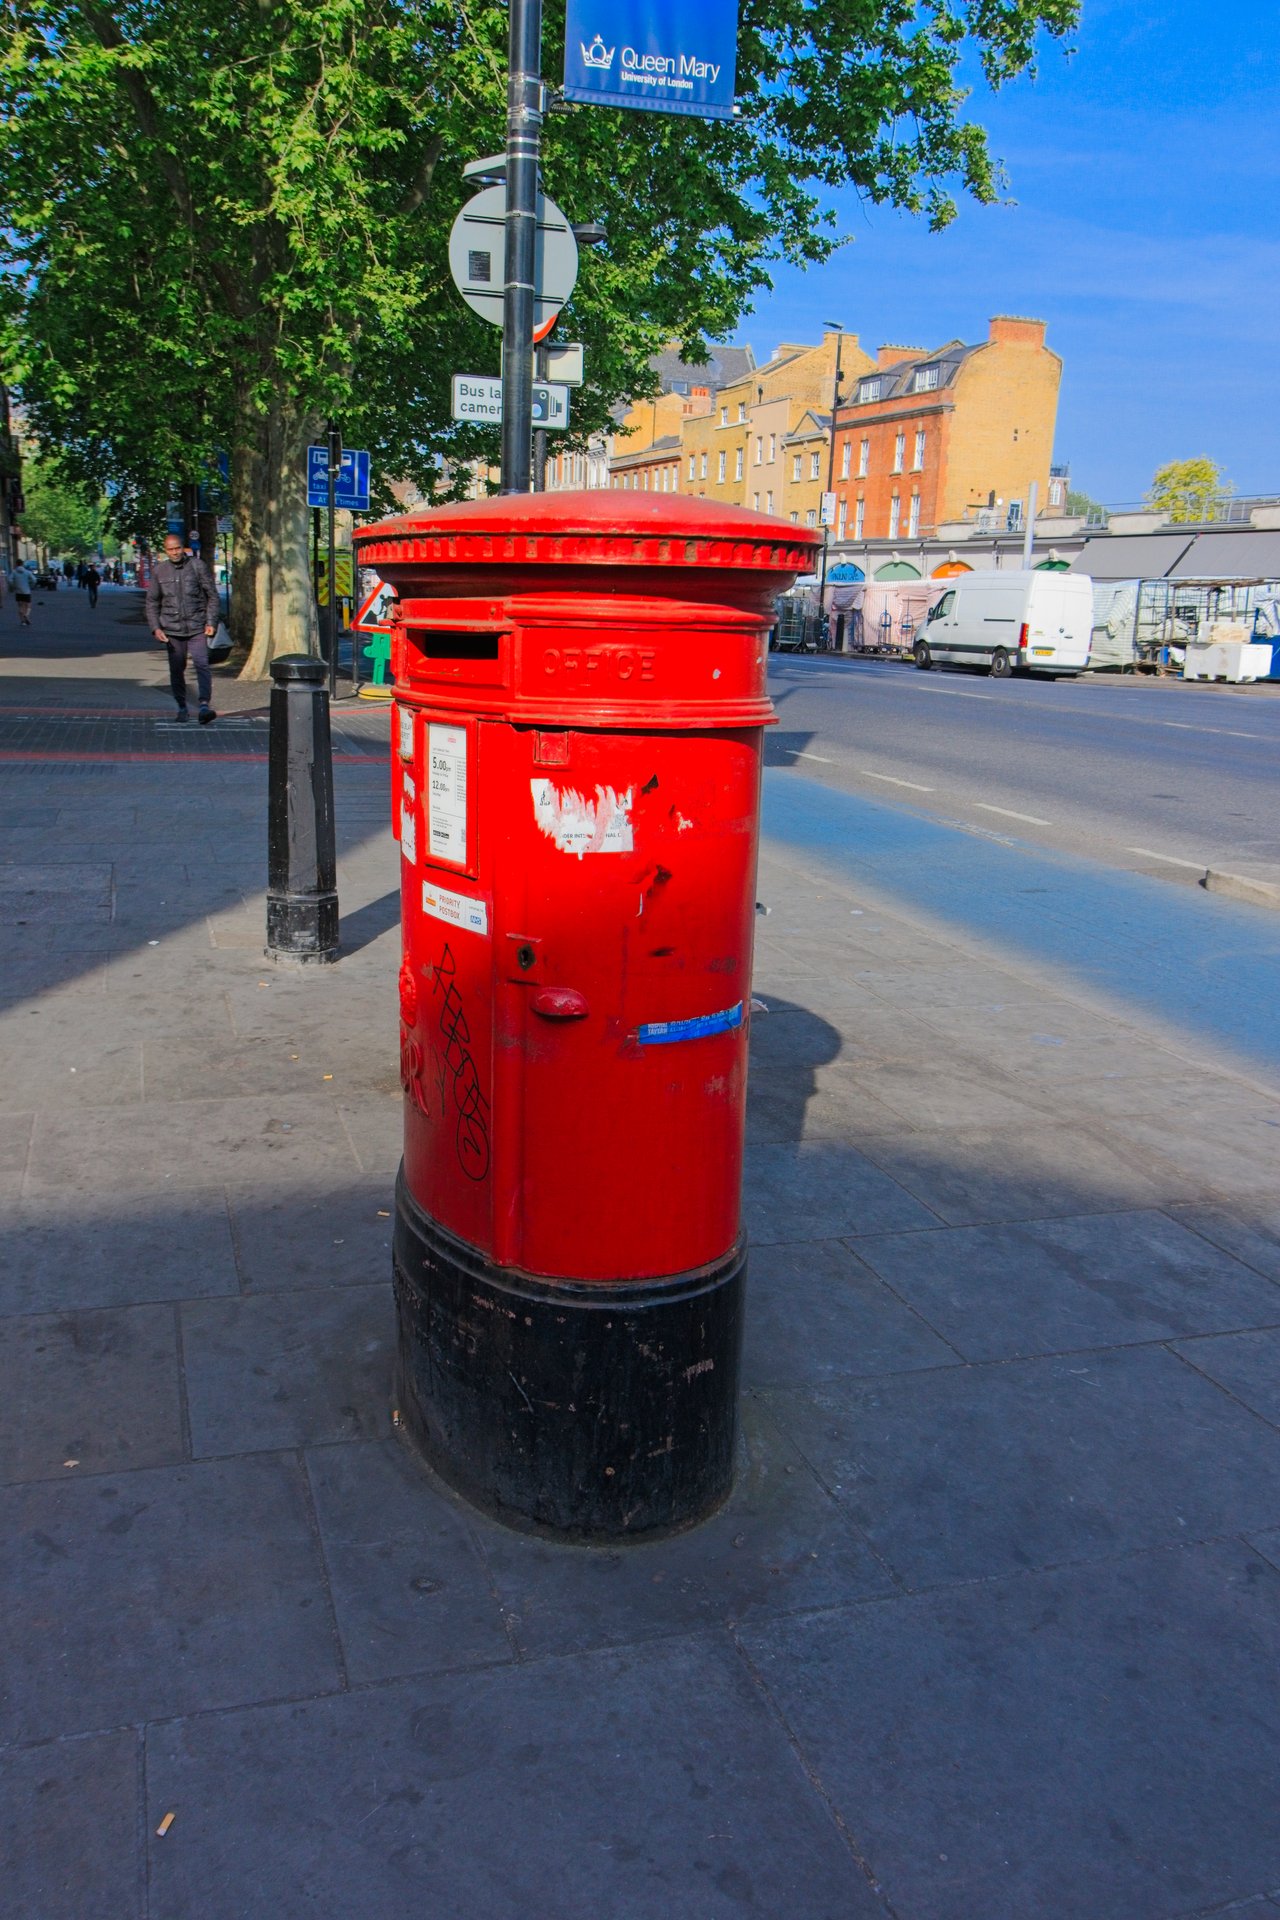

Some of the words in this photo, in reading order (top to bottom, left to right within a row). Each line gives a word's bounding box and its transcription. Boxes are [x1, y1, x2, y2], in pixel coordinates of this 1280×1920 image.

[621, 47, 675, 74] Queen
[679, 54, 721, 84] Mary
[621, 71, 657, 86] University
[658, 76, 667, 86] of
[667, 77, 694, 89] London
[460, 383, 485, 398] Bus
[489, 386, 502, 399] la
[460, 402, 503, 415] camer
[544, 648, 656, 681] OFFICE
[439, 894, 461, 909] PRIORITY
[439, 906, 460, 920] POSTBOX
